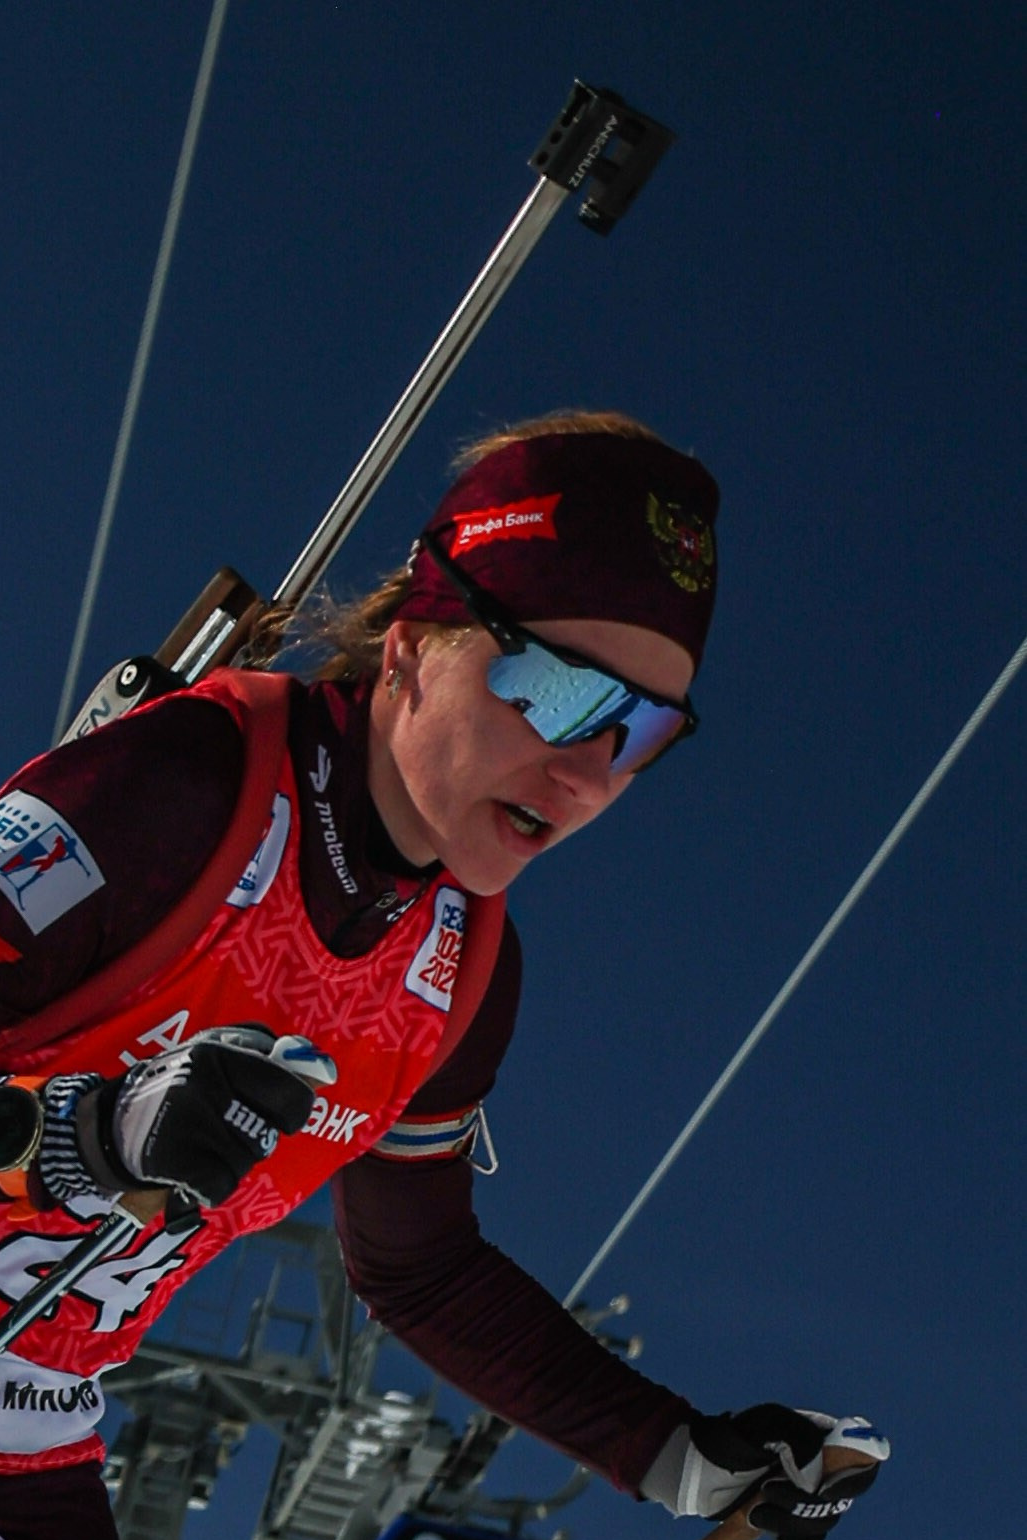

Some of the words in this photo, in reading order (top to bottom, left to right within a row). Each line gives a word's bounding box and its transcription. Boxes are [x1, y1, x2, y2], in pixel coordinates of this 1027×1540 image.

[459, 518, 503, 544] Альфа
[505, 512, 544, 528] Банк
[314, 801, 359, 895] proteam
